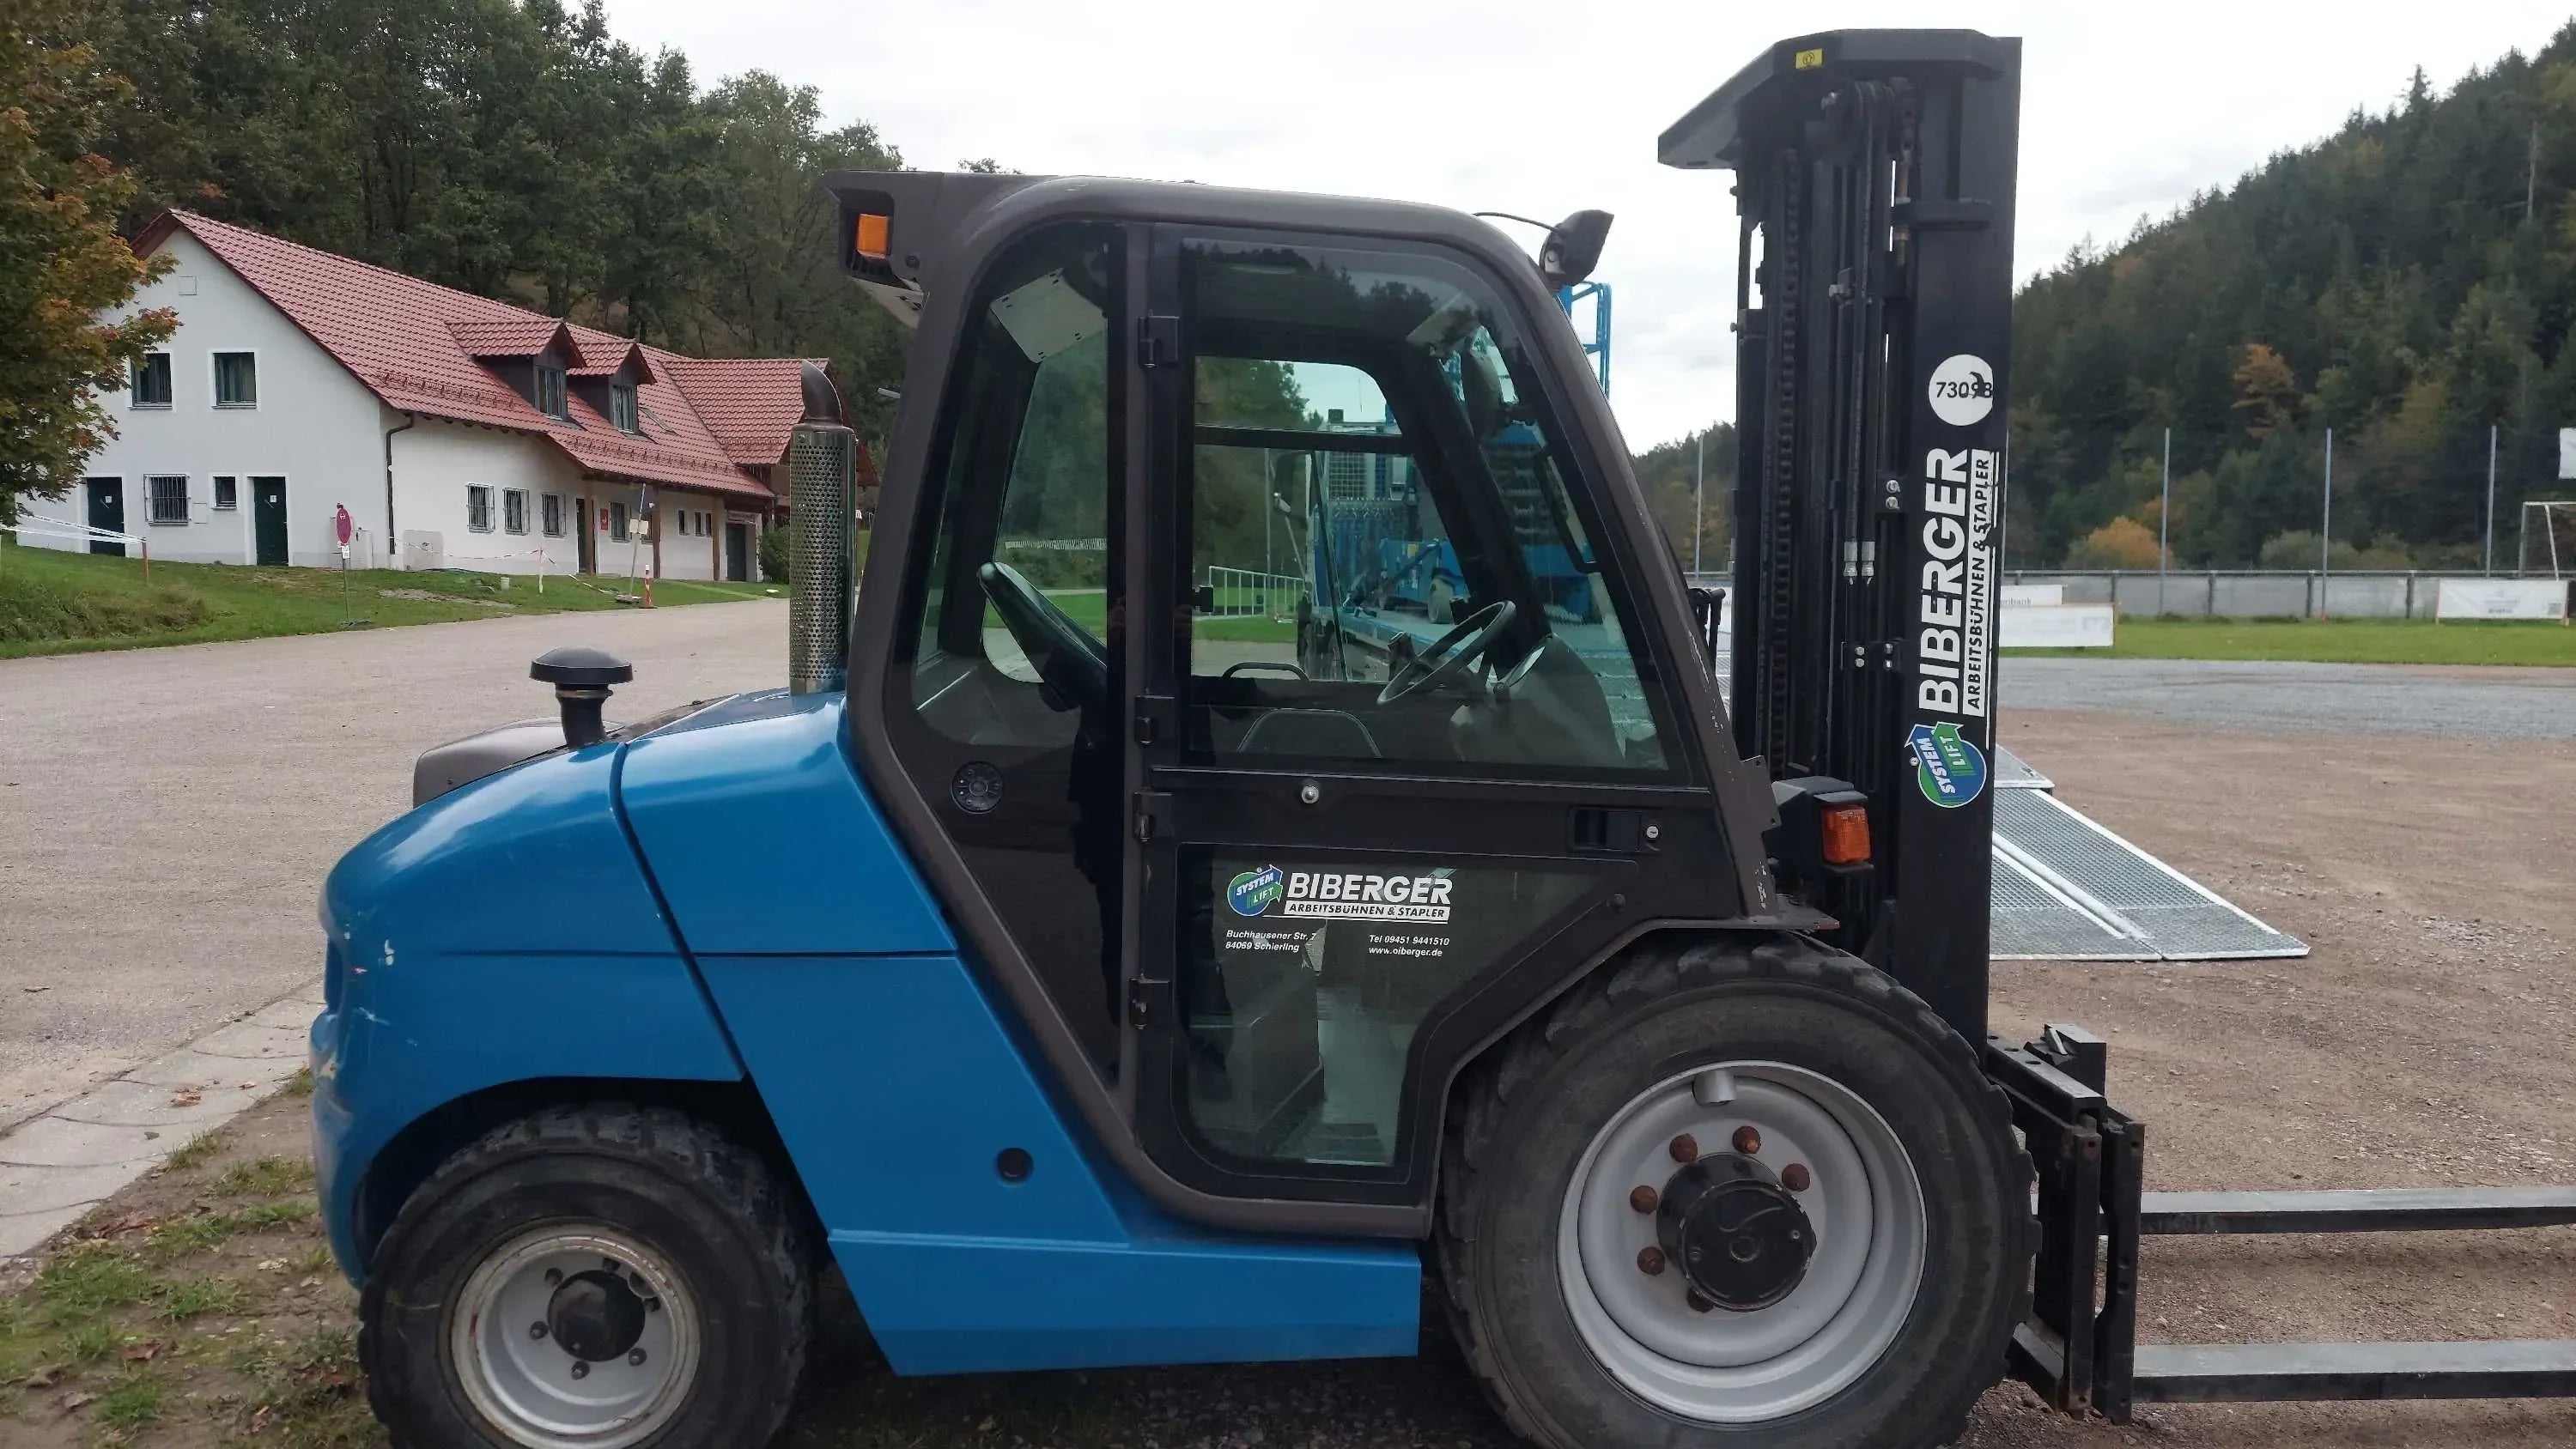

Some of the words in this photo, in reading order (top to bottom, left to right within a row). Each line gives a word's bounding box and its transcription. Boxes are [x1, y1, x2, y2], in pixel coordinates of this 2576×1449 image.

[1973, 458, 1990, 535] STAPLER
[1972, 538, 1987, 553] &
[1918, 447, 1968, 714] BIBERGER
[1967, 557, 1986, 710] ARBEITSBÜHNEN
[1939, 736, 1966, 766] LIFT
[1916, 737, 1956, 794] SYSTEM
[1236, 872, 1274, 896] SYSTEM
[1253, 887, 1274, 903] LIFT
[1286, 872, 1453, 905] BIBERGER
[1289, 903, 1385, 915] ARBEITSBÜHNEN
[1387, 906, 1395, 916] &
[1397, 906, 1445, 918] STAPLER
[1225, 941, 1253, 950] 84069
[1254, 942, 1300, 953] Schierling
[1226, 930, 1291, 940] Buchhausener
[1369, 934, 1383, 943] Tel
[1384, 935, 1410, 944] 09451
[1412, 936, 1450, 946] 9441510
